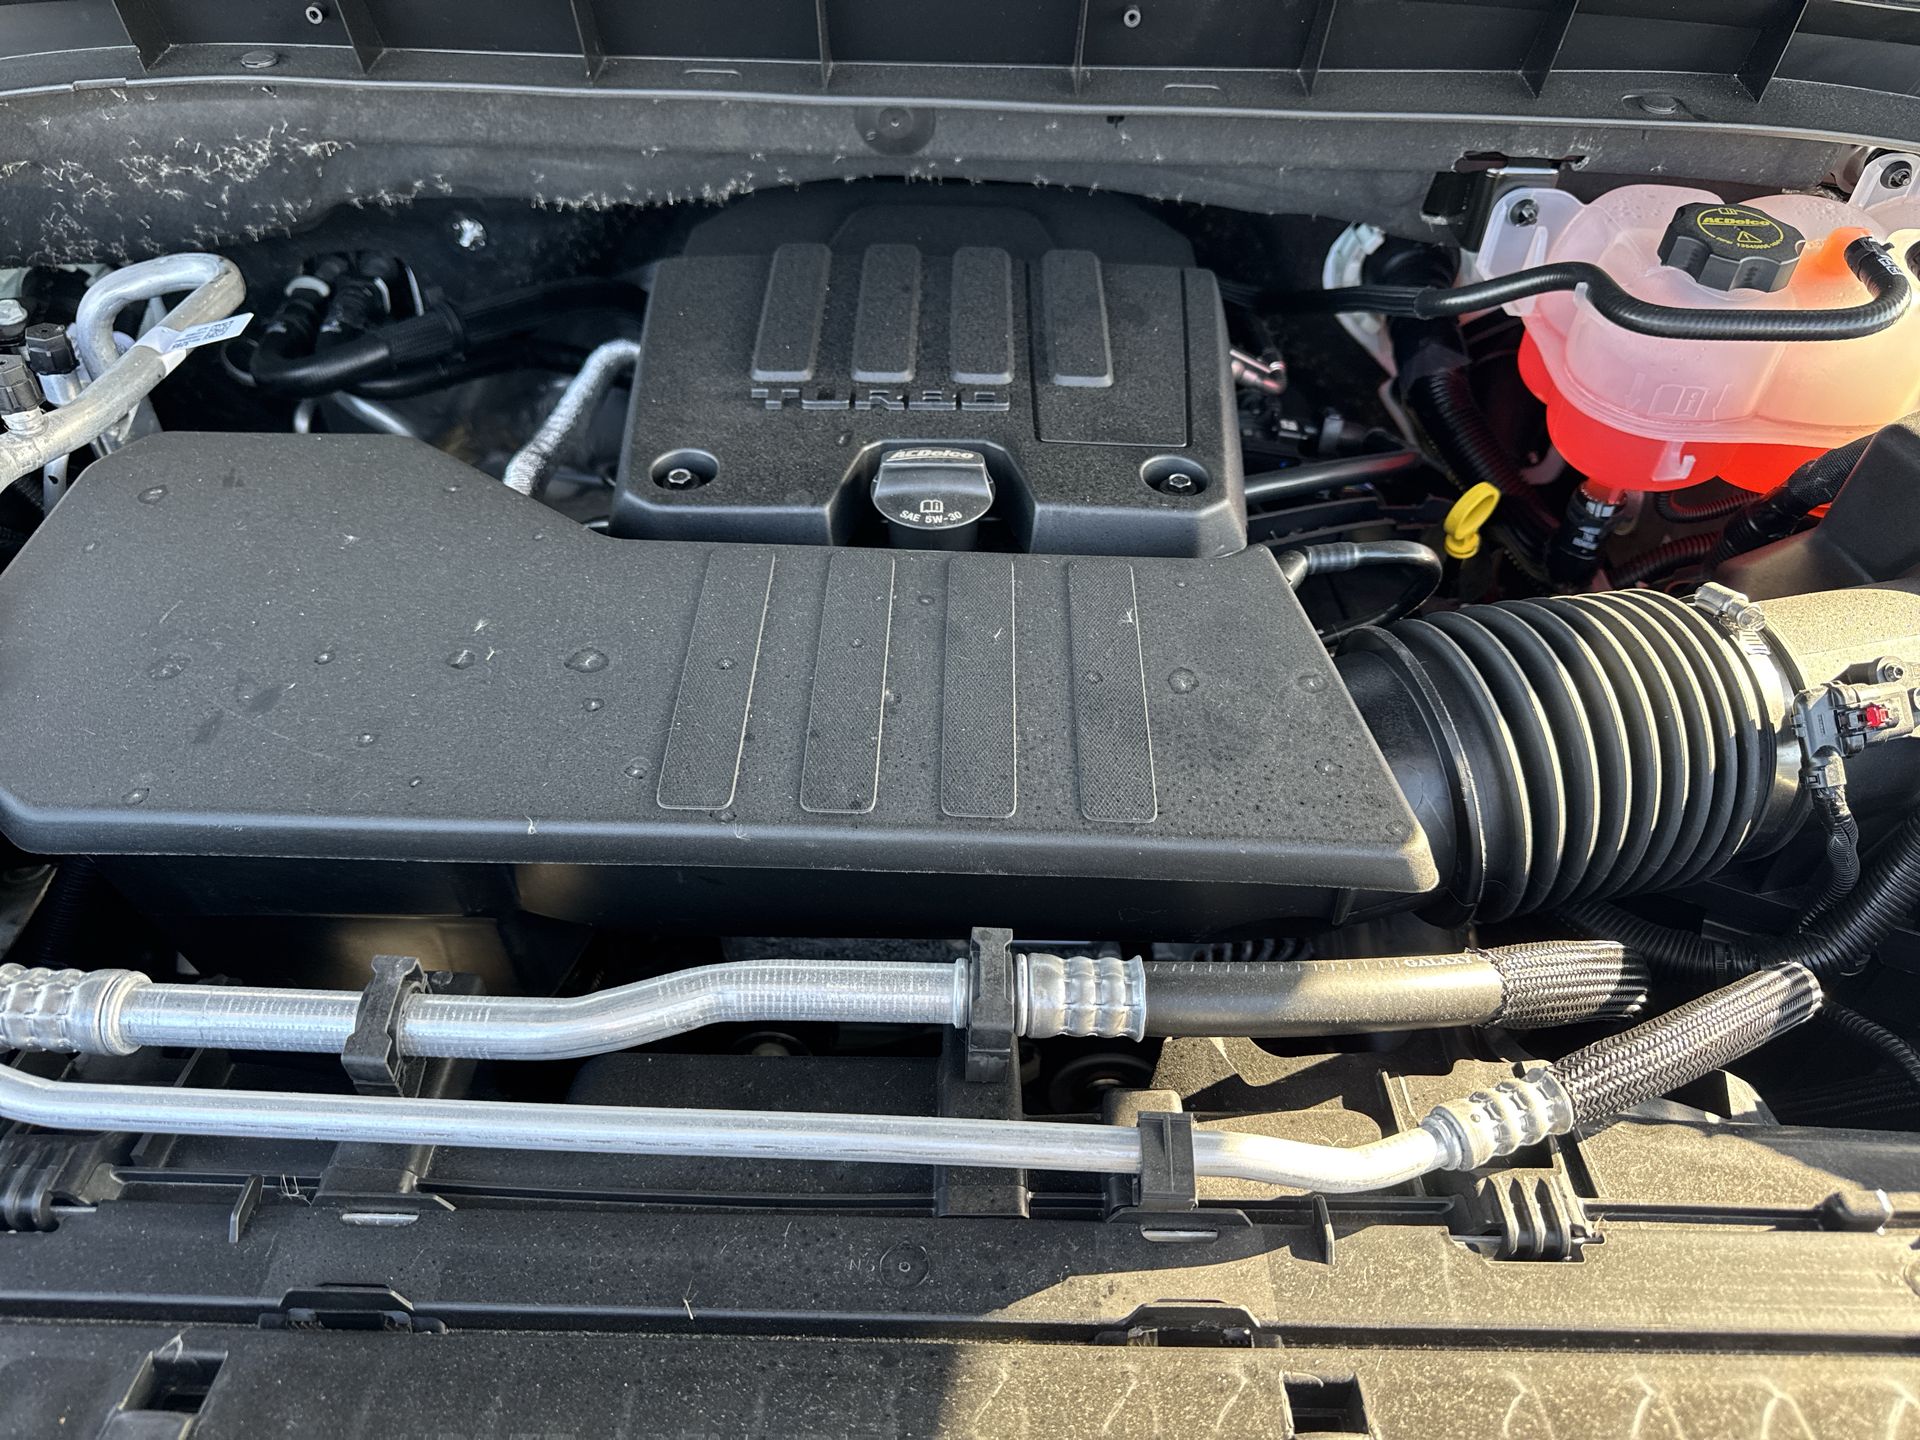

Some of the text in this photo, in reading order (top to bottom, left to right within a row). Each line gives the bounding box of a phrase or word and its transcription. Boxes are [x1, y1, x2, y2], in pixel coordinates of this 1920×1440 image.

[1702, 217, 1771, 226] ACDelco
[750, 382, 1010, 411] TURBO
[888, 449, 975, 460] ACDelco
[900, 510, 963, 524] SAE 5W-30
[1404, 956, 1473, 968] GALAXY
